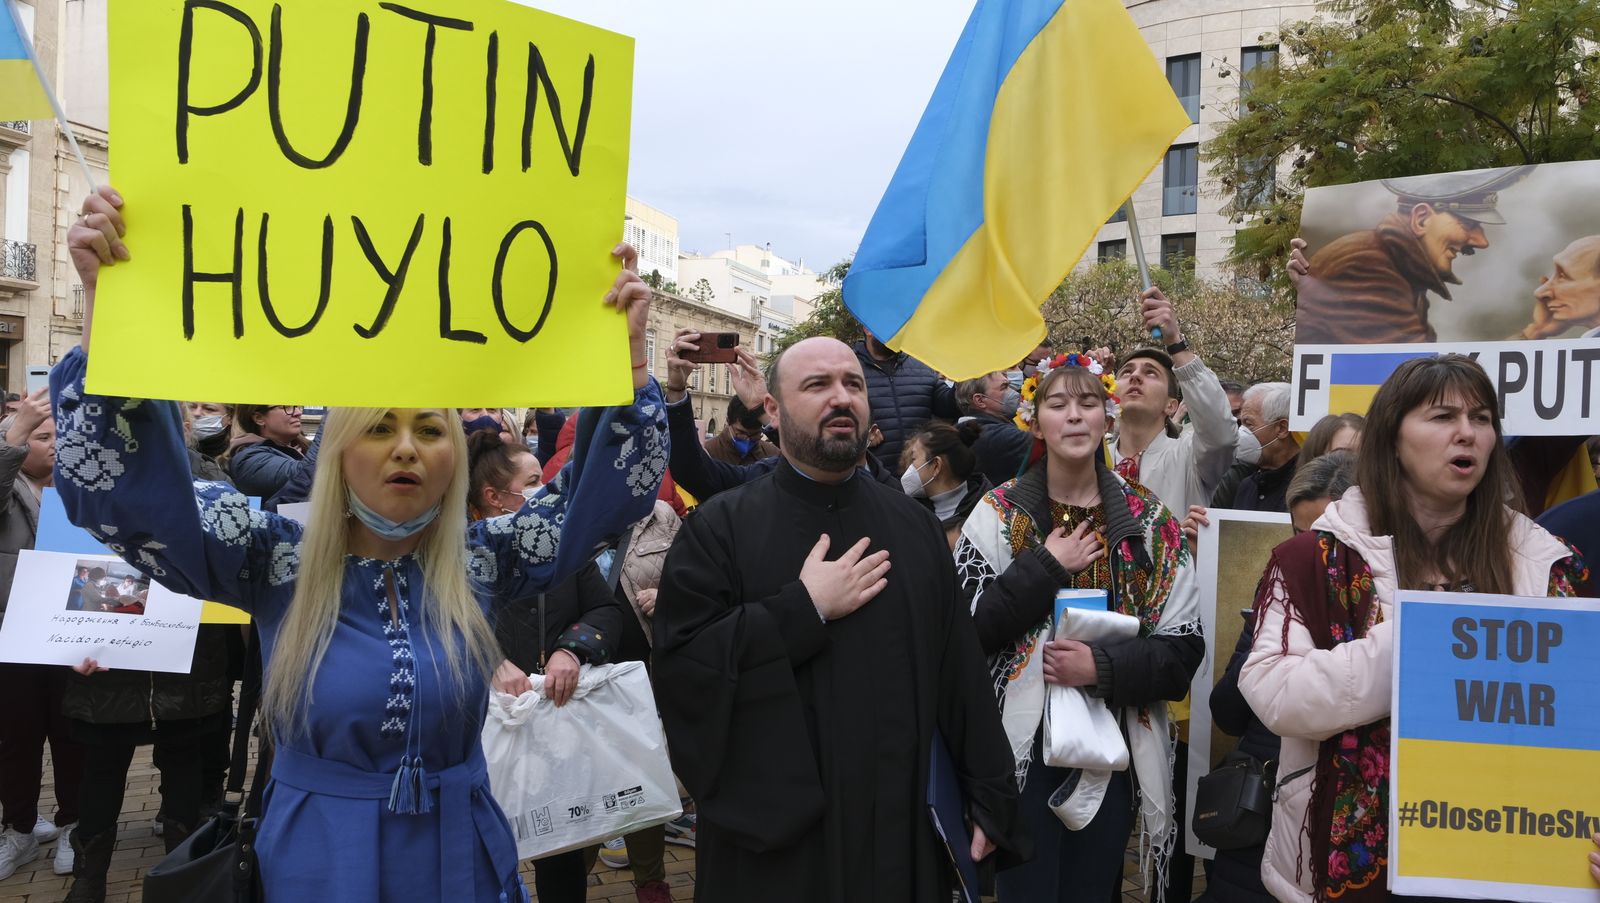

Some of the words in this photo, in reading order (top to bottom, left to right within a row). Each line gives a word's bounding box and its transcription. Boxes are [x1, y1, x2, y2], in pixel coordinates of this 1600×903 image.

[176, 0, 594, 177] PUTIN
[182, 205, 558, 344] HUYLO
[47, 633, 91, 644] Nacido
[1452, 616, 1563, 664] STOP
[1454, 678, 1556, 727] WAR
[567, 804, 590, 819] 70%
